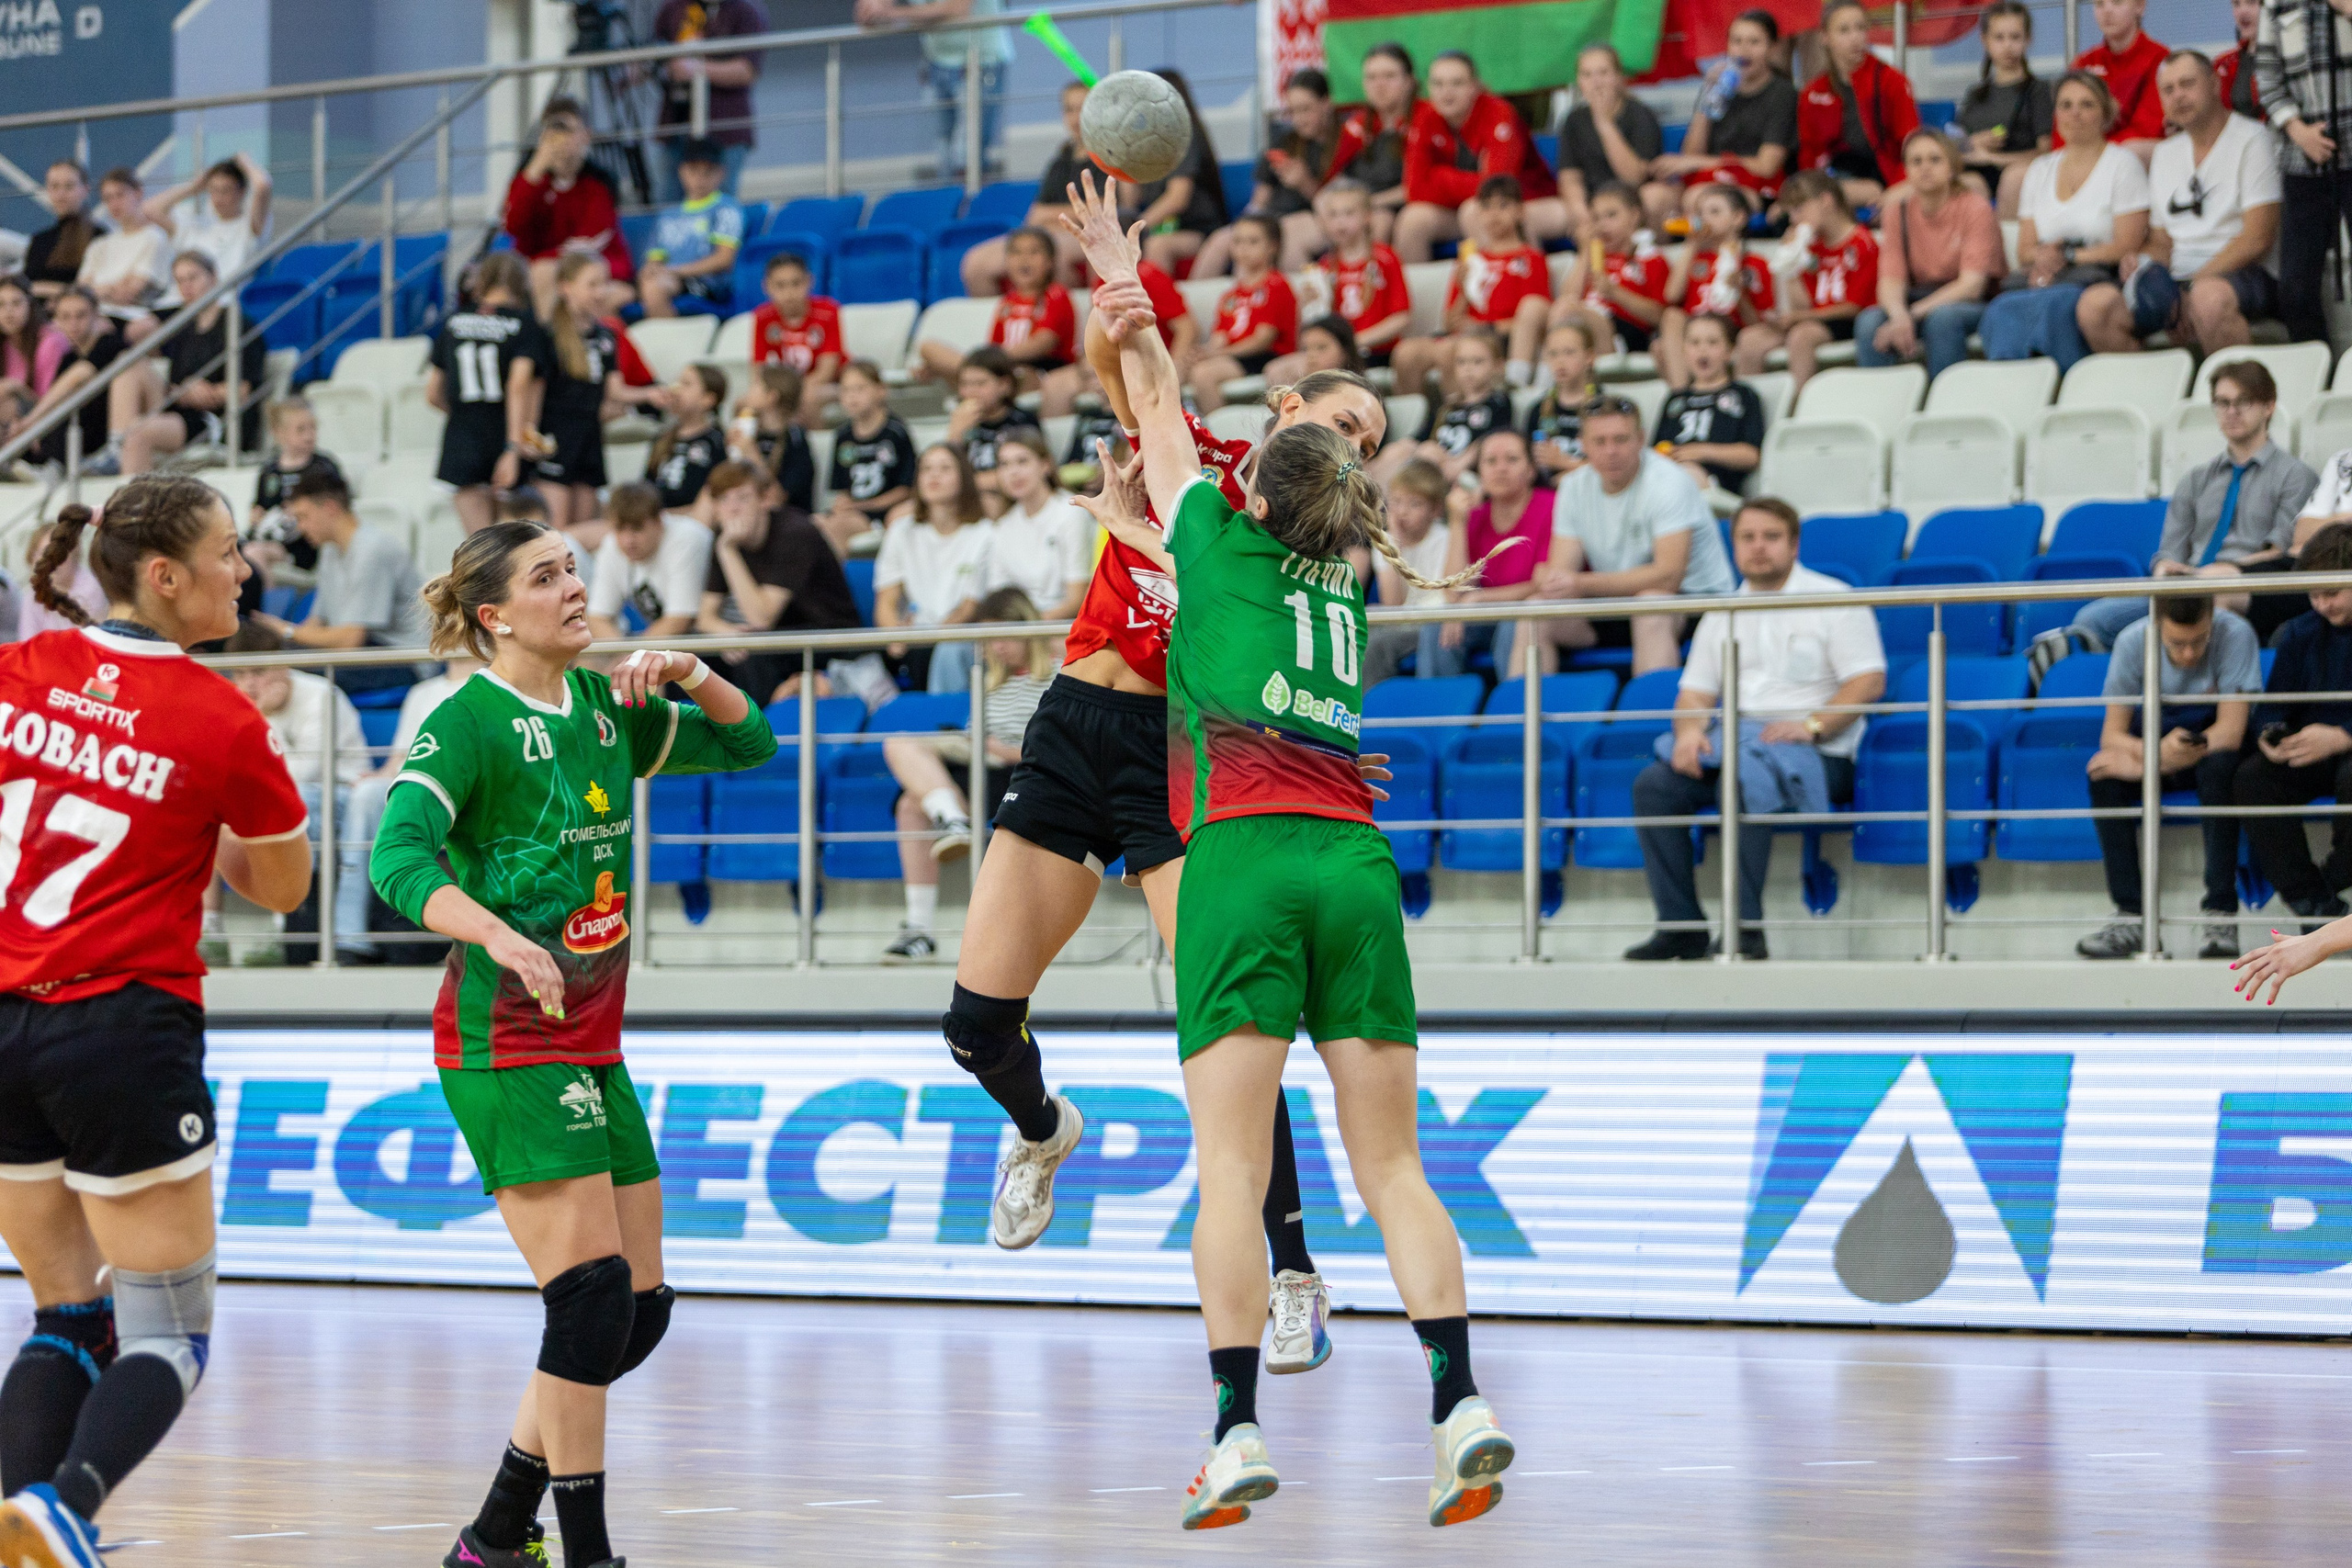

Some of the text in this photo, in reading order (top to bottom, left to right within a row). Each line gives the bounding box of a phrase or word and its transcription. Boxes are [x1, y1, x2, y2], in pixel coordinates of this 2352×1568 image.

[456, 342, 503, 403] 11
[1283, 589, 1359, 687] 10
[48, 687, 141, 739] SPORTIX
[1293, 689, 1360, 738] BelFert
[512, 716, 553, 762] 26
[0, 778, 131, 929] 17
[594, 842, 615, 863] ДСК
[566, 1122, 594, 1132] ГОРОДА
